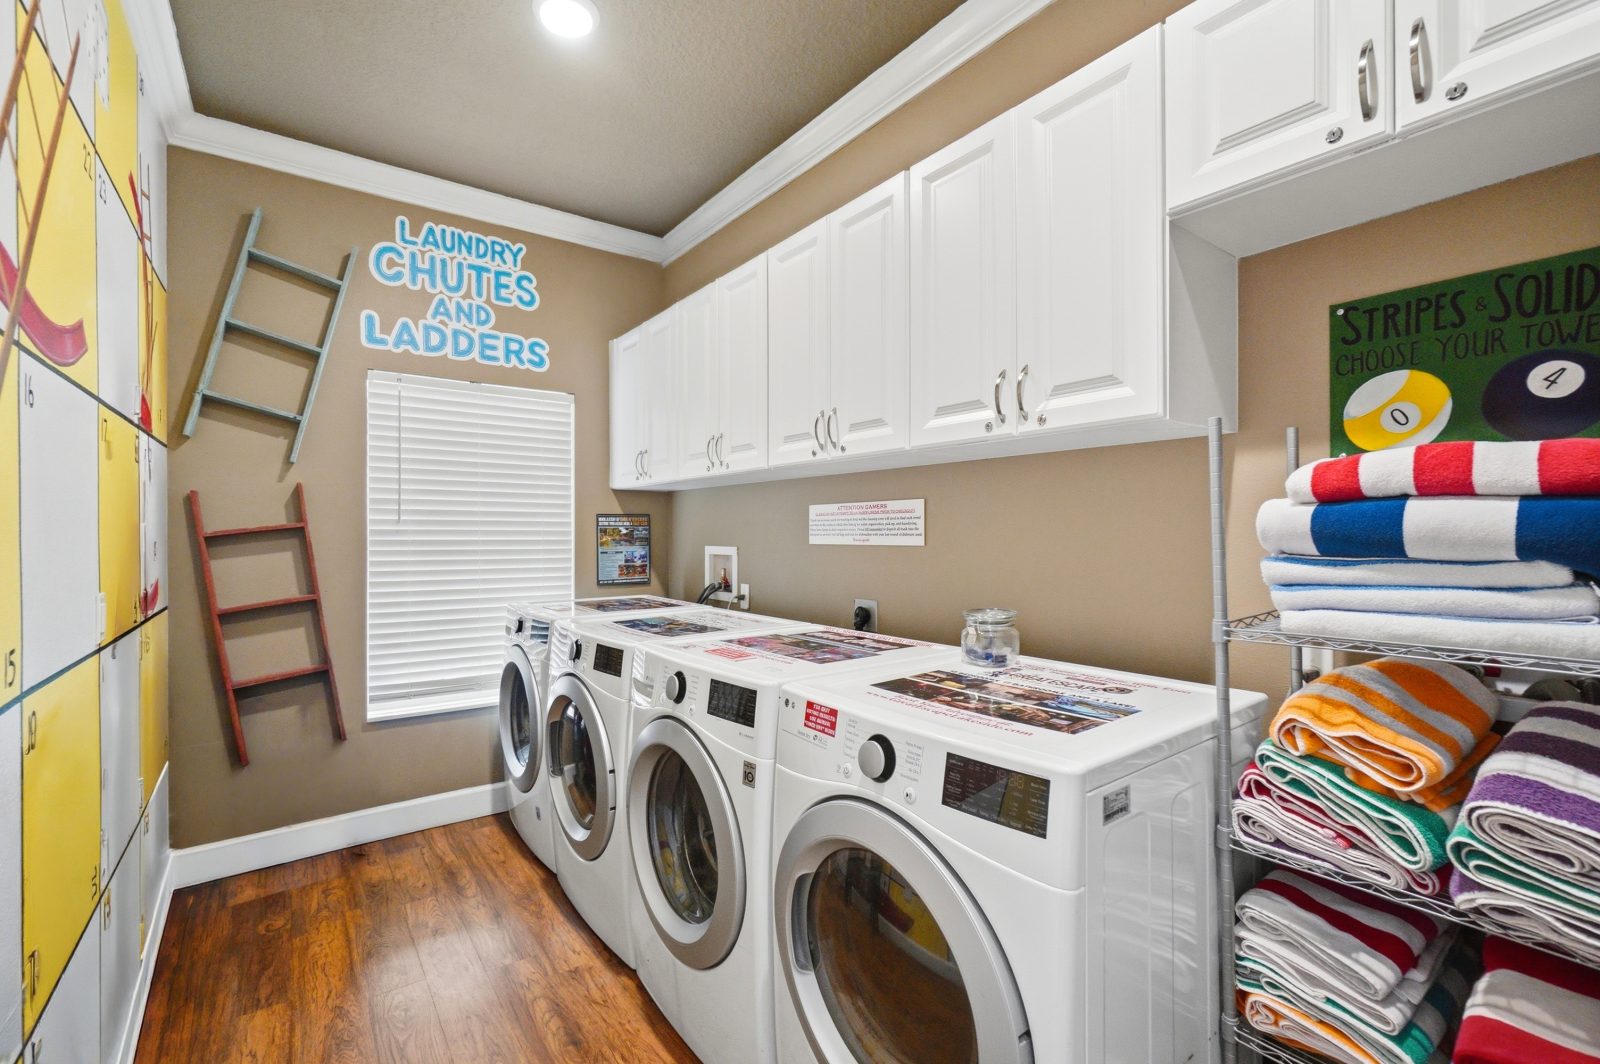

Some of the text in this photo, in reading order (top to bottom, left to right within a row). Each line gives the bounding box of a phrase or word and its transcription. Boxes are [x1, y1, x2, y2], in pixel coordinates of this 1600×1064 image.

[398, 217, 525, 269] LAUNDRY
[371, 244, 538, 309] CHUTES
[430, 296, 493, 328] AND
[1340, 290, 1467, 346] STRIPES
[1475, 296, 1488, 312] &
[363, 312, 548, 370] LADDERS
[1336, 341, 1422, 377] CHOOSE
[1435, 328, 1507, 362] YOUR
[1543, 367, 1567, 390] 4
[1391, 408, 1409, 426] 0
